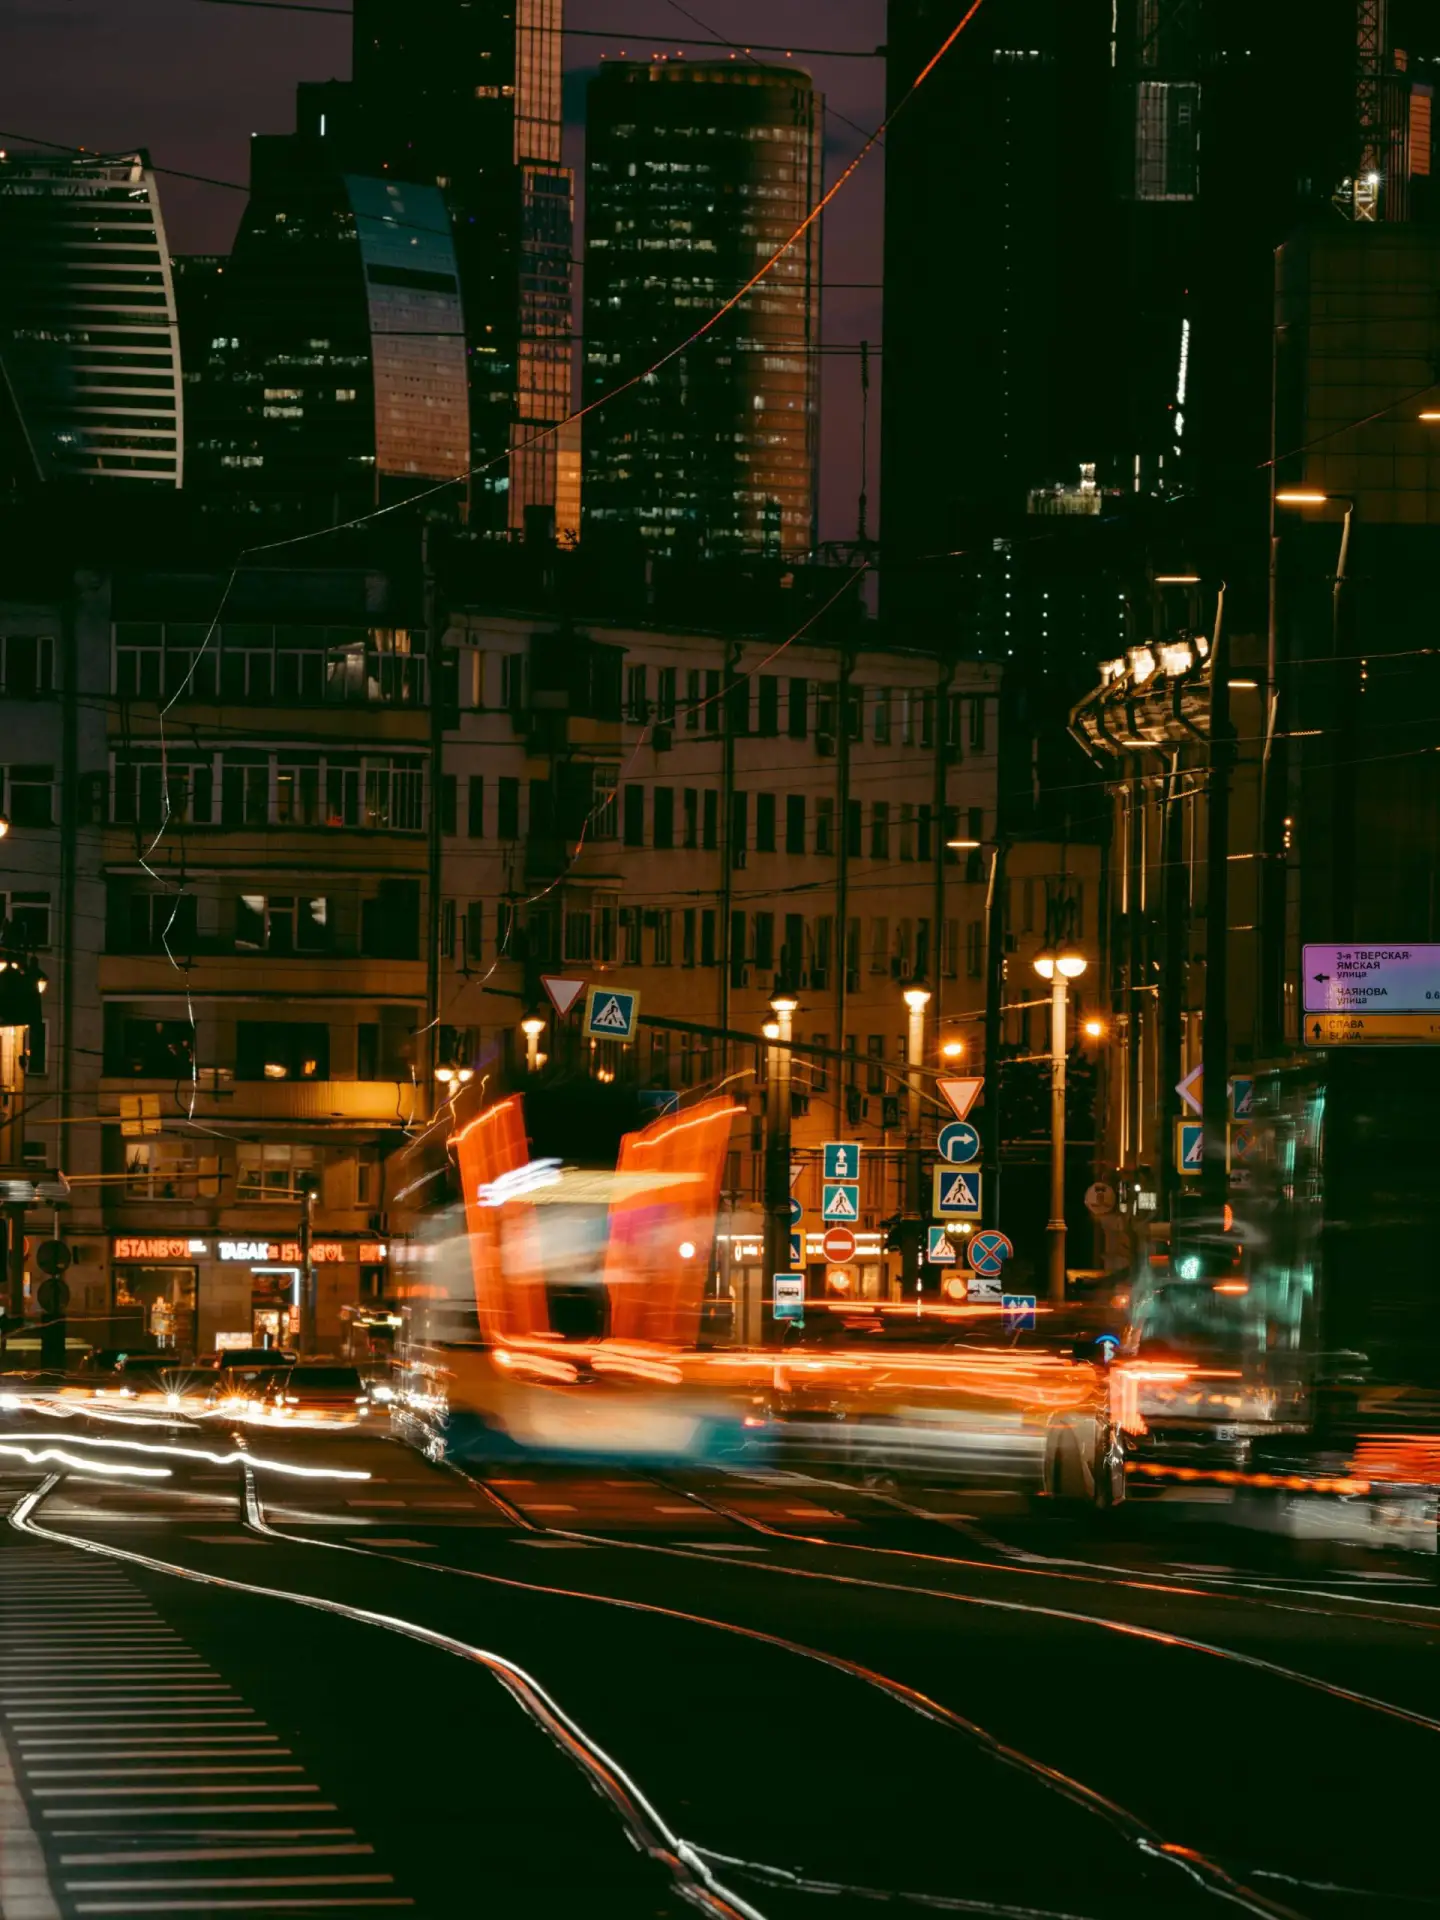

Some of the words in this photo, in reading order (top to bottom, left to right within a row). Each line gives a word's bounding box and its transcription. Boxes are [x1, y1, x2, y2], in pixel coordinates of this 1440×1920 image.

[1336, 951, 1352, 960] 3-я
[1336, 961, 1381, 970] ЯМСКАЯ
[1336, 971, 1367, 980] улица
[1337, 987, 1388, 996] ЧАЯНОВА
[1336, 997, 1367, 1005] улица
